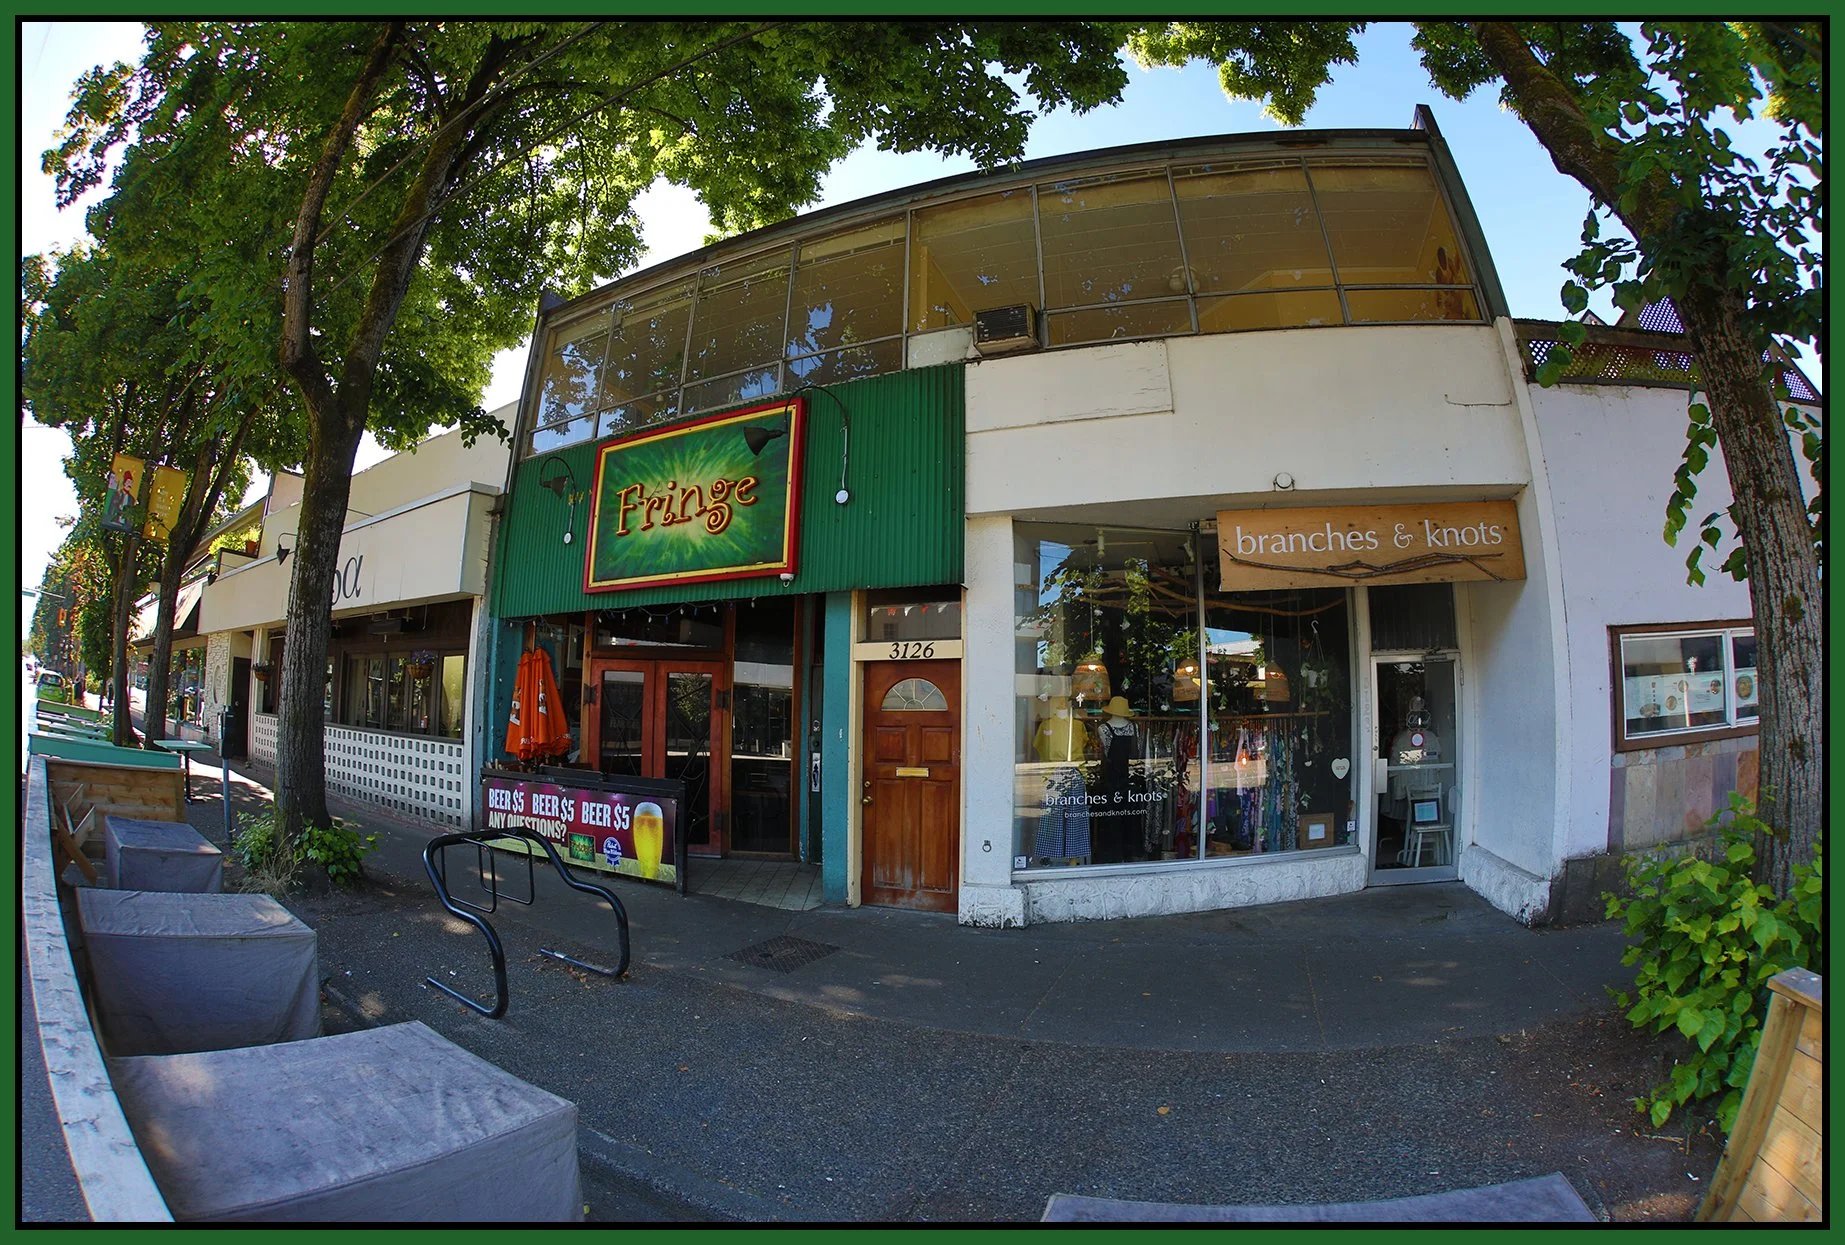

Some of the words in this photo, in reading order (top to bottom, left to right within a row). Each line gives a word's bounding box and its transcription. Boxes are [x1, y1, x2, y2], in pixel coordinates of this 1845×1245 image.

[616, 475, 759, 536] Fringe
[1236, 522, 1379, 555] branches
[1394, 523, 1413, 549] &
[1424, 519, 1502, 548] knots
[889, 641, 935, 660] 3126
[1046, 791, 1107, 807] branches
[1113, 792, 1124, 804] &
[1128, 790, 1163, 803] knots
[488, 788, 511, 810] BEER
[512, 789, 525, 814] $5
[532, 793, 559, 818] BEER
[560, 797, 575, 823] $5
[581, 801, 611, 828] BEER
[614, 803, 631, 831] $5
[1064, 808, 1148, 819] branchesandknots.com
[488, 811, 506, 829] ANY
